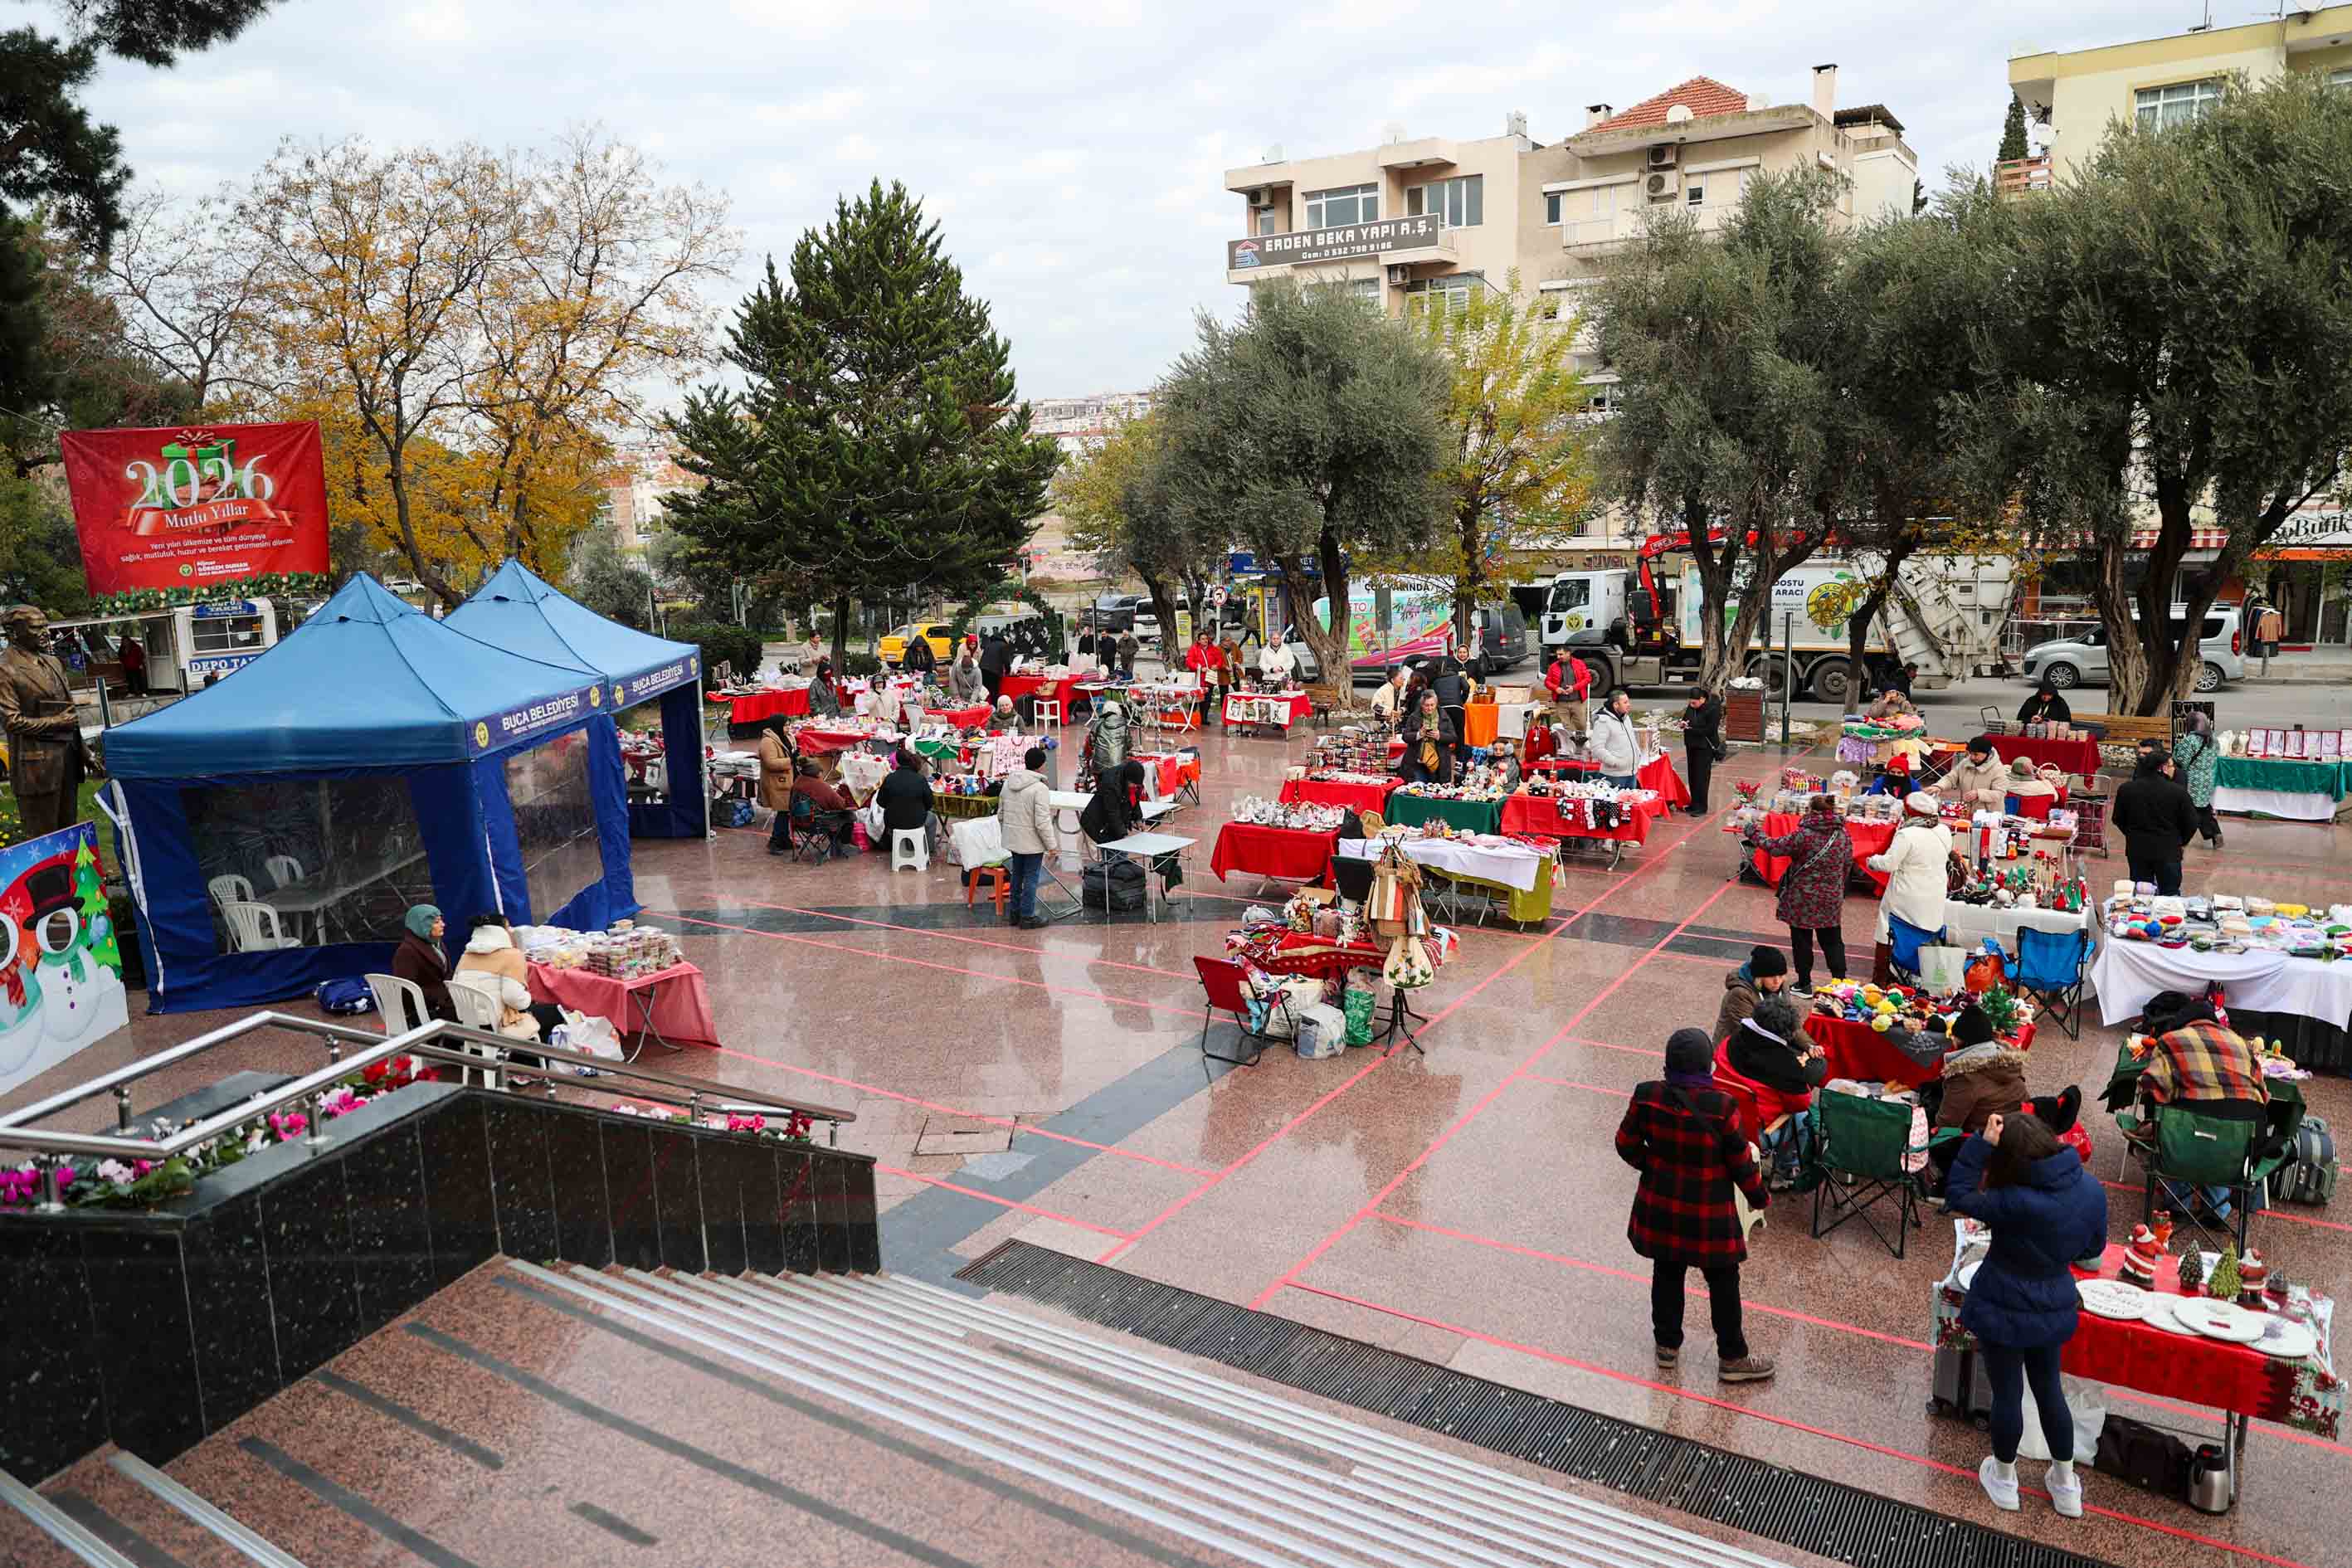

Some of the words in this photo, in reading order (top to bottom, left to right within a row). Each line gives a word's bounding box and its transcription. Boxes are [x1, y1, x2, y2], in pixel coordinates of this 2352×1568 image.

[1265, 234, 1311, 252] ERDEN
[1316, 228, 1355, 246] BEKA
[1361, 224, 1395, 241] YAPI
[1400, 220, 1434, 236] A.Ş.
[126, 454, 273, 509] 2026
[165, 510, 207, 528] Mutlu
[210, 503, 249, 519] Yıllar
[149, 542, 166, 550] Yeni
[183, 538, 212, 548] ülkemize
[223, 535, 237, 543] tüm
[207, 544, 233, 553] bereket
[192, 658, 228, 673] DEPO
[231, 656, 256, 669] TA
[632, 676, 651, 692] BUCA
[650, 661, 684, 685] BELEDİYESİ
[502, 711, 529, 731] BUCA
[529, 691, 580, 722] BELEDİYESİ
